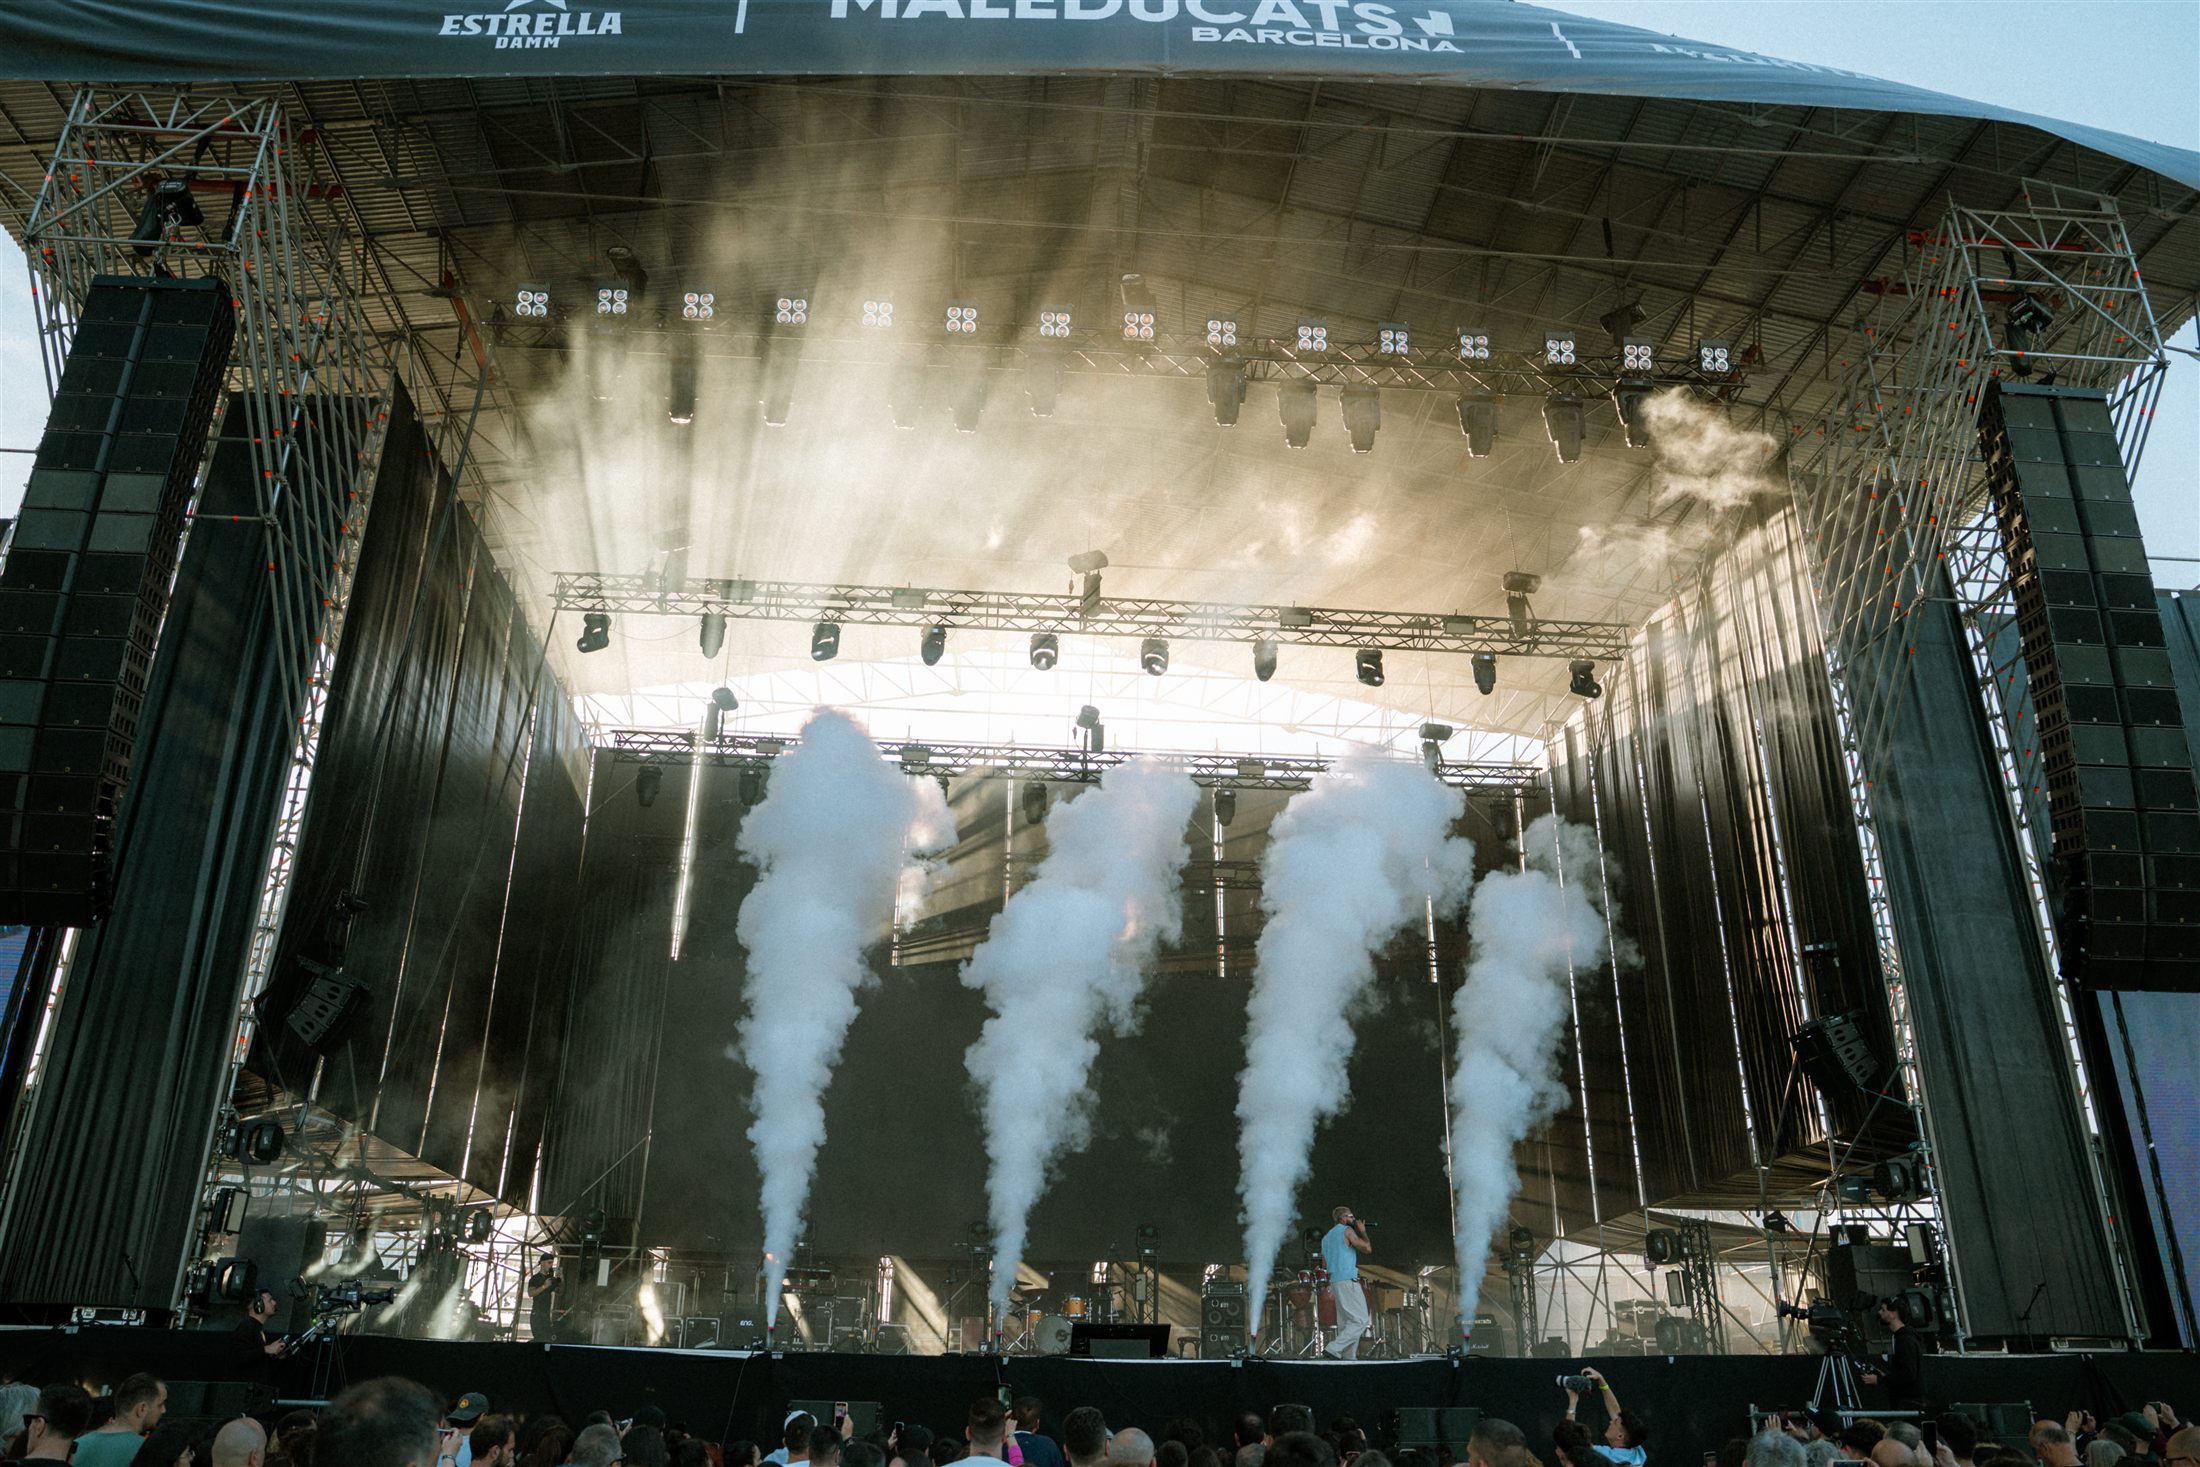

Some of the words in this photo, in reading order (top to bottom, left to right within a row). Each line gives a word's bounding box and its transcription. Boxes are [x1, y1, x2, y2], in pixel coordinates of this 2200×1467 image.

[438, 12, 622, 36] ESTRELLA
[830, 0, 1404, 36] MALEDUCATS
[495, 36, 560, 49] DAMM
[1192, 27, 1465, 53] BARCELONA
